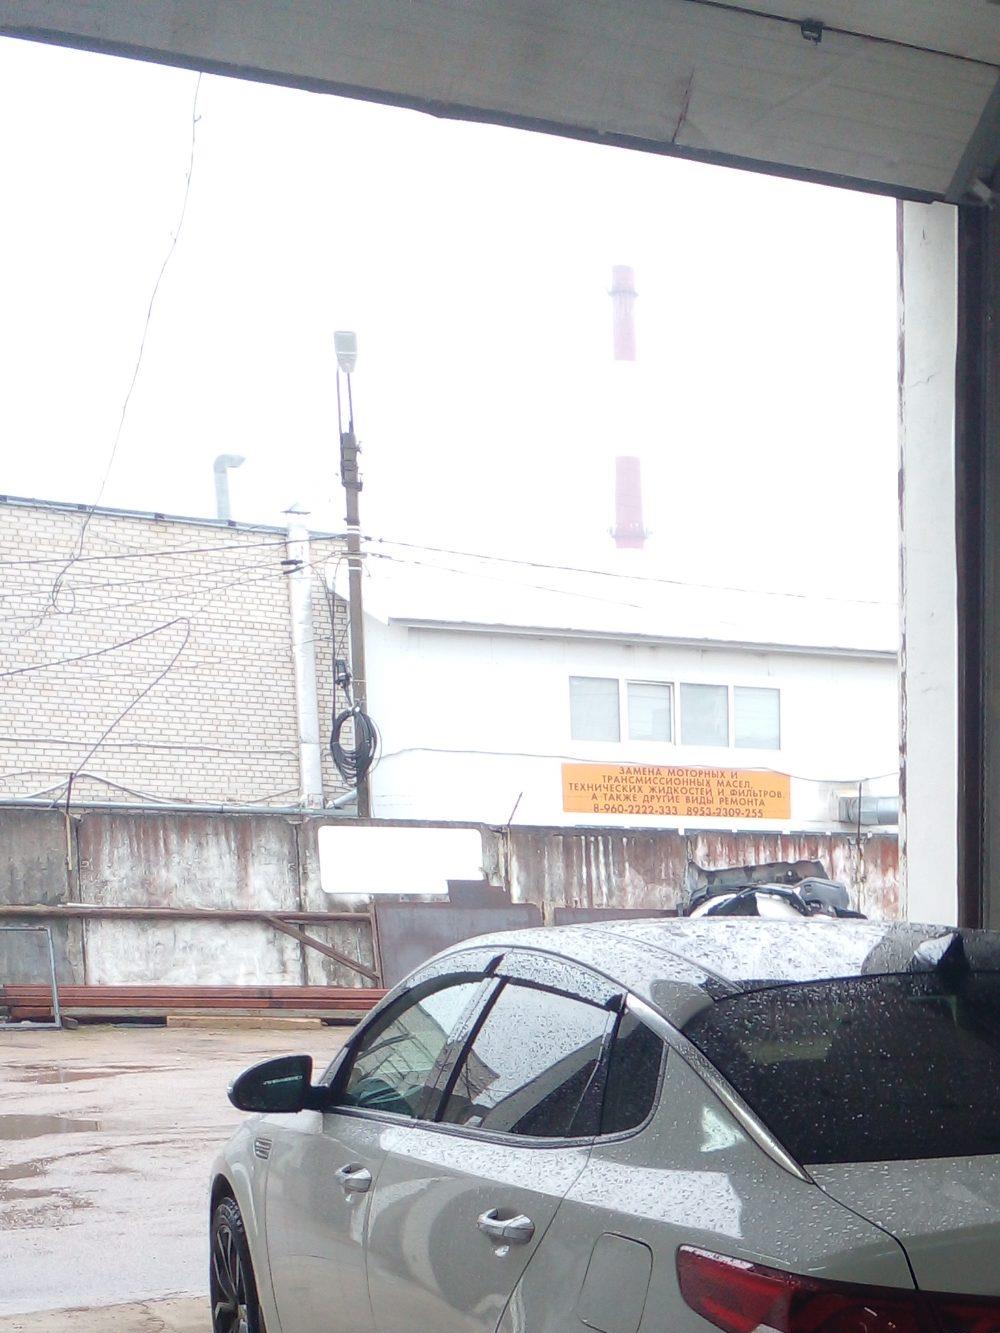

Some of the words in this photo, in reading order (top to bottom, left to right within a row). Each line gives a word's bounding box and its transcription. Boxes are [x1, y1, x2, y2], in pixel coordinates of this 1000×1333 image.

[619, 766, 662, 776] ЗАМЕНА
[667, 768, 726, 779] МОТОРНЫХ
[731, 771, 738, 779] И
[602, 775, 711, 787] ТРАНСМИССИОННЫХ
[717, 780, 754, 789] МАСЕЛ,
[569, 782, 643, 794] ТЕХНИЧЕСКИХ
[649, 785, 712, 796] ЖИДКОСТЕЙ
[718, 788, 725, 797] И
[591, 793, 598, 801] А
[604, 793, 638, 802] ТАКЖЕ
[643, 795, 680, 804] ДРУГИЕ
[686, 796, 713, 806] ВИДЫ
[720, 797, 765, 807] РЕМОНТА
[593, 803, 678, 815] 8-960-2222-333
[686, 806, 764, 818] 8953-2309-255
